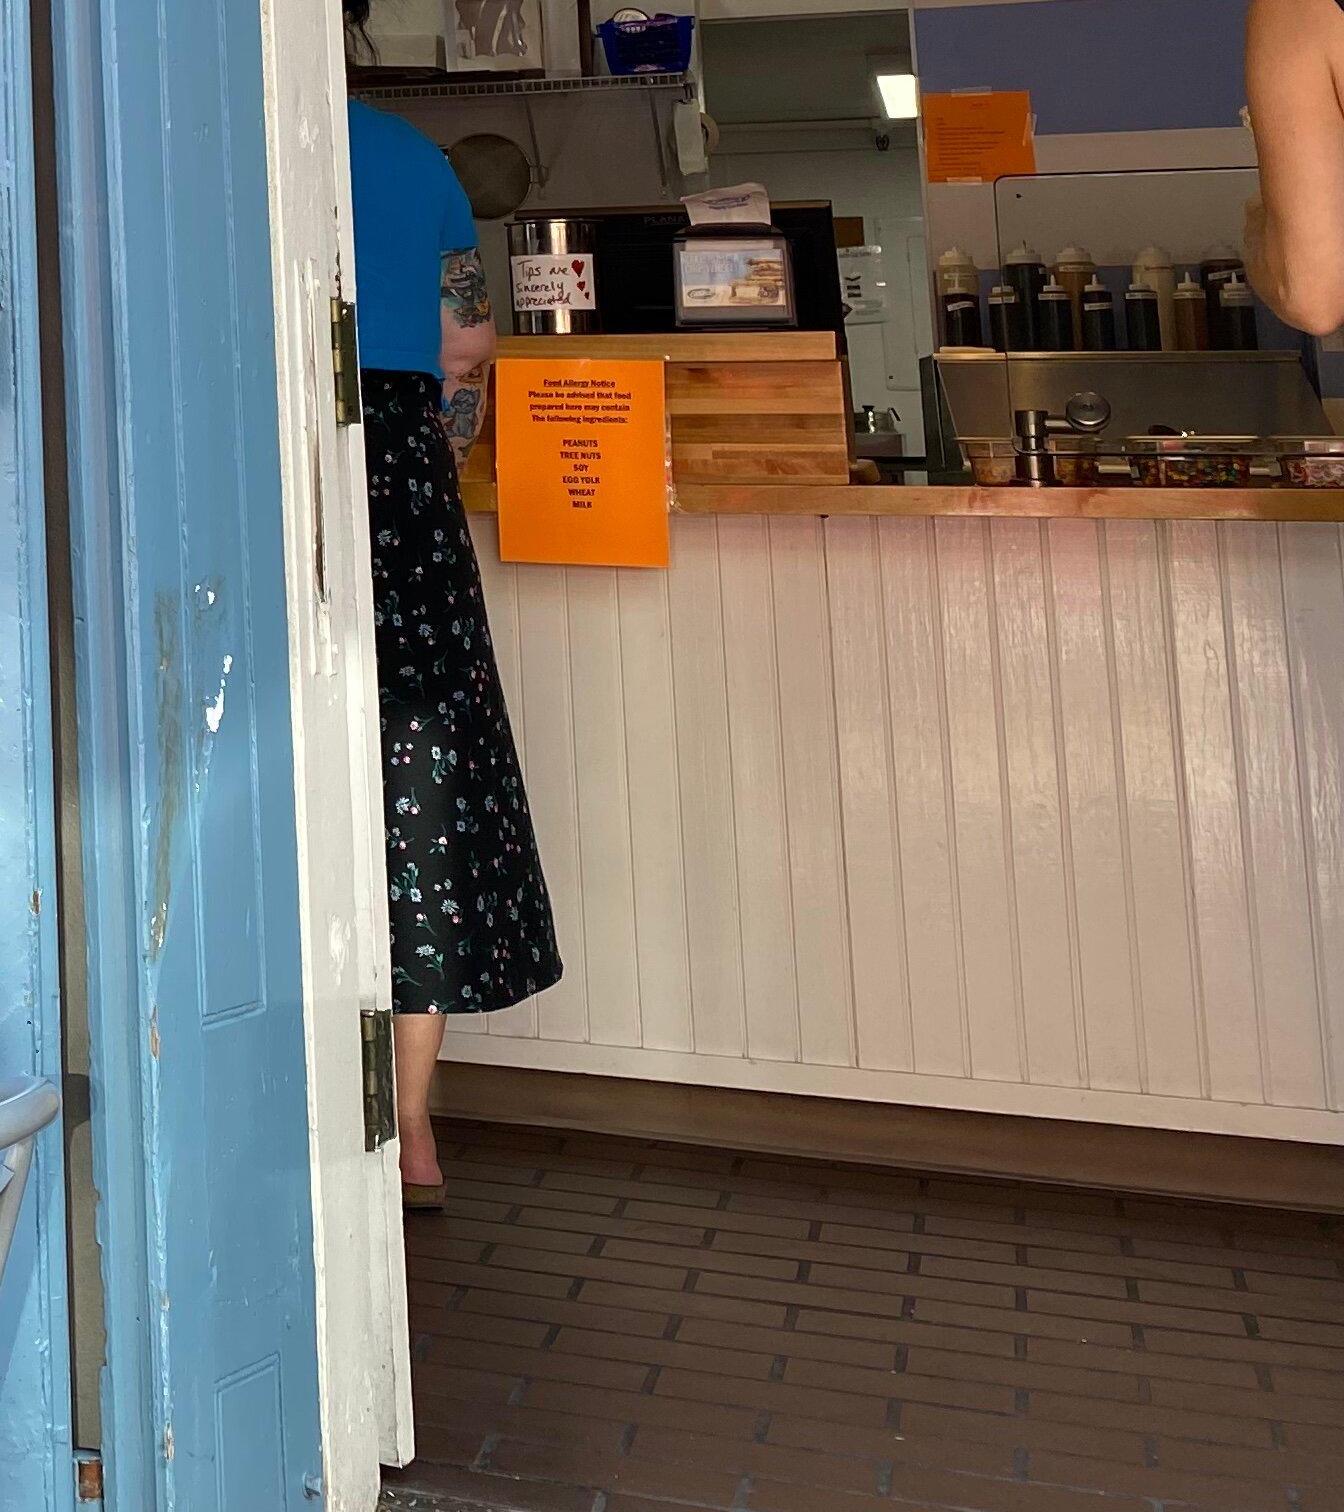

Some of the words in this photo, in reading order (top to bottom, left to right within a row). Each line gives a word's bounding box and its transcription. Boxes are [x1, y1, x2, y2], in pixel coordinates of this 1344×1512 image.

[517, 259, 541, 281] Tips
[549, 266, 569, 276] are
[543, 379, 562, 388] Food
[563, 379, 590, 388] Allergy
[591, 379, 616, 388] Notice
[528, 391, 553, 399] Please
[555, 391, 565, 399] be
[597, 391, 612, 399] that
[584, 403, 600, 412] may
[562, 439, 598, 448] PEANUTS
[560, 451, 579, 460] TREE
[581, 451, 602, 460] NUTS
[573, 464, 589, 473] SOY
[562, 476, 580, 484] EGG
[581, 476, 601, 484] YOLK
[568, 488, 596, 497] WHEAT
[572, 500, 593, 509] MILK
